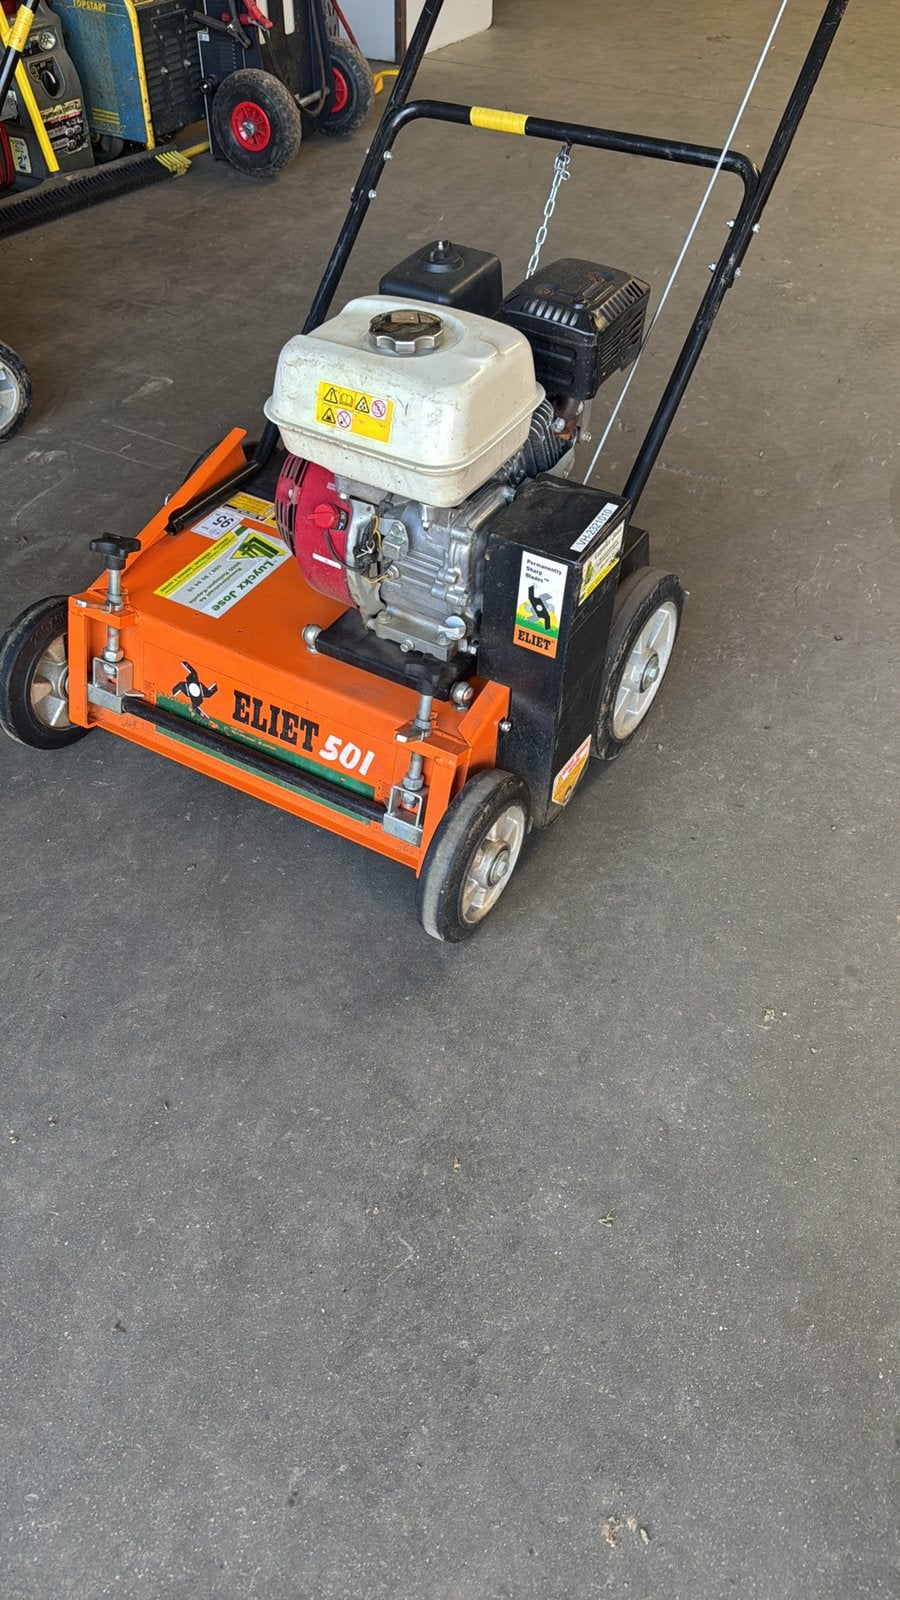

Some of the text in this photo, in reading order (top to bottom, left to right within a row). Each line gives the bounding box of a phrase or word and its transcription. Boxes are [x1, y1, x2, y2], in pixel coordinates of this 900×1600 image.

[73, 0, 107, 12] TOPSTART
[212, 515, 234, 528] 95
[577, 508, 612, 546] VH-2321010
[236, 560, 275, 590] Luyckx
[526, 559, 563, 576] Permanently
[526, 566, 543, 576] Sharp
[211, 590, 238, 611] Jose
[517, 629, 551, 651] ELIET
[232, 690, 376, 776] ELIET 501
